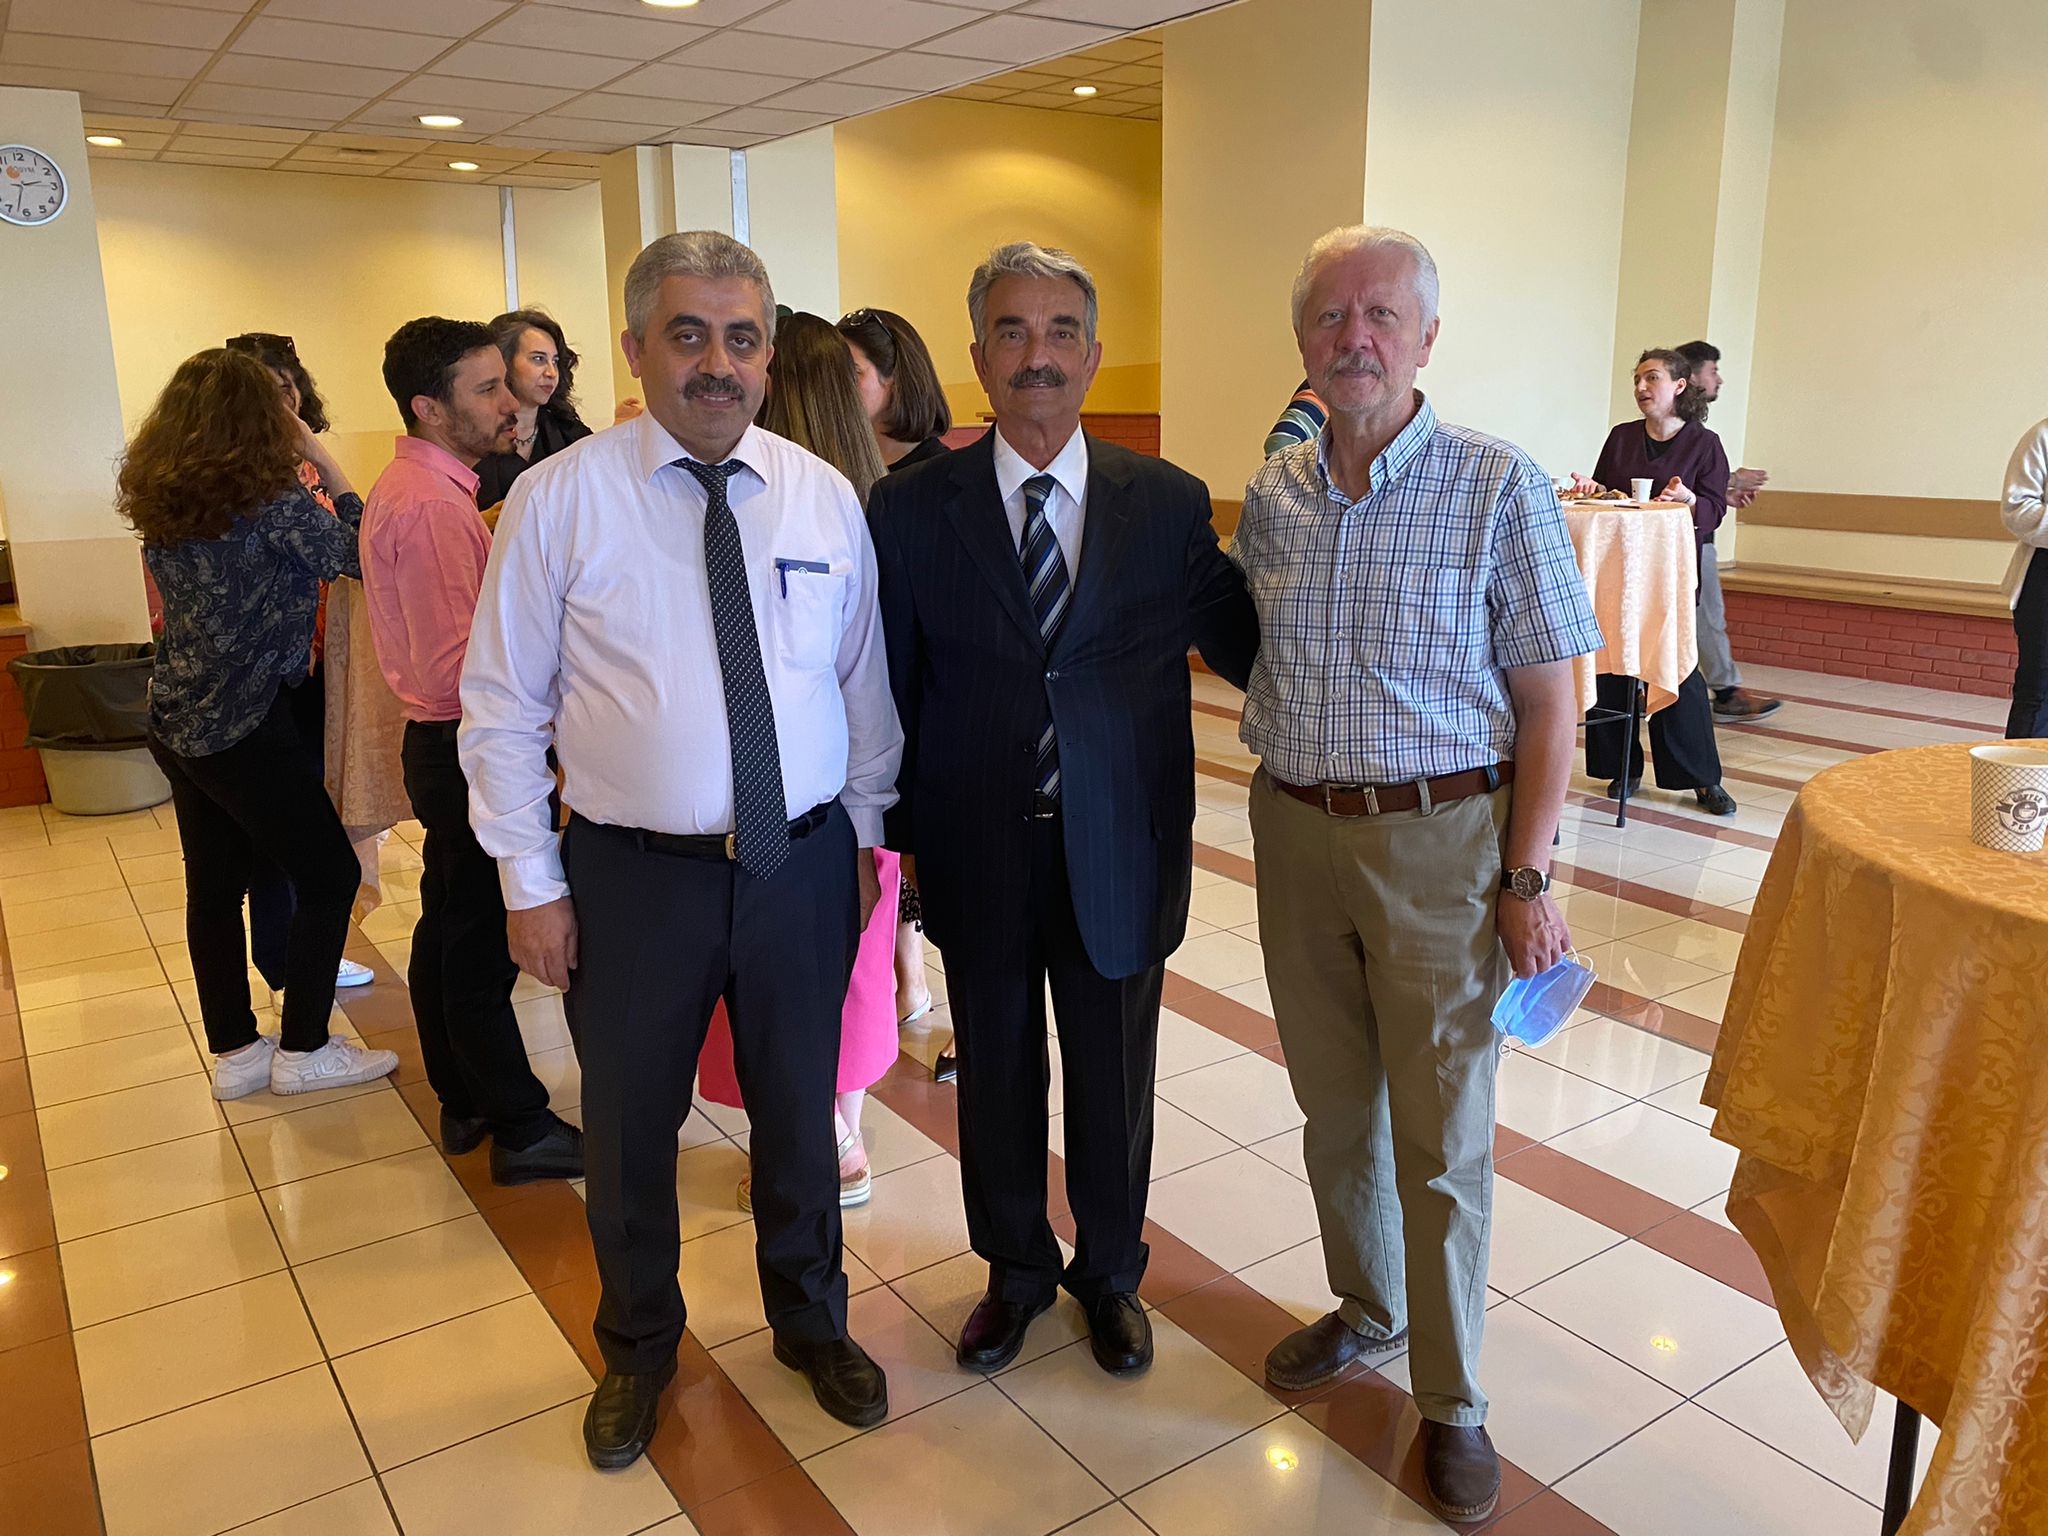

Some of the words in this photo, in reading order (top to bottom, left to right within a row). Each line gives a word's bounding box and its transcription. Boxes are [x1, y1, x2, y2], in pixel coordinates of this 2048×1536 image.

[13, 152, 25, 161] 12
[34, 157, 37, 166] 1
[43, 167, 51, 176] 2
[50, 182, 58, 190] 3
[48, 196, 55, 204] 4
[4, 204, 13, 213] 7
[22, 208, 31, 217] 6
[39, 205, 47, 213] 5
[2011, 821, 2031, 830] TEA
[297, 1056, 350, 1077] FILA
